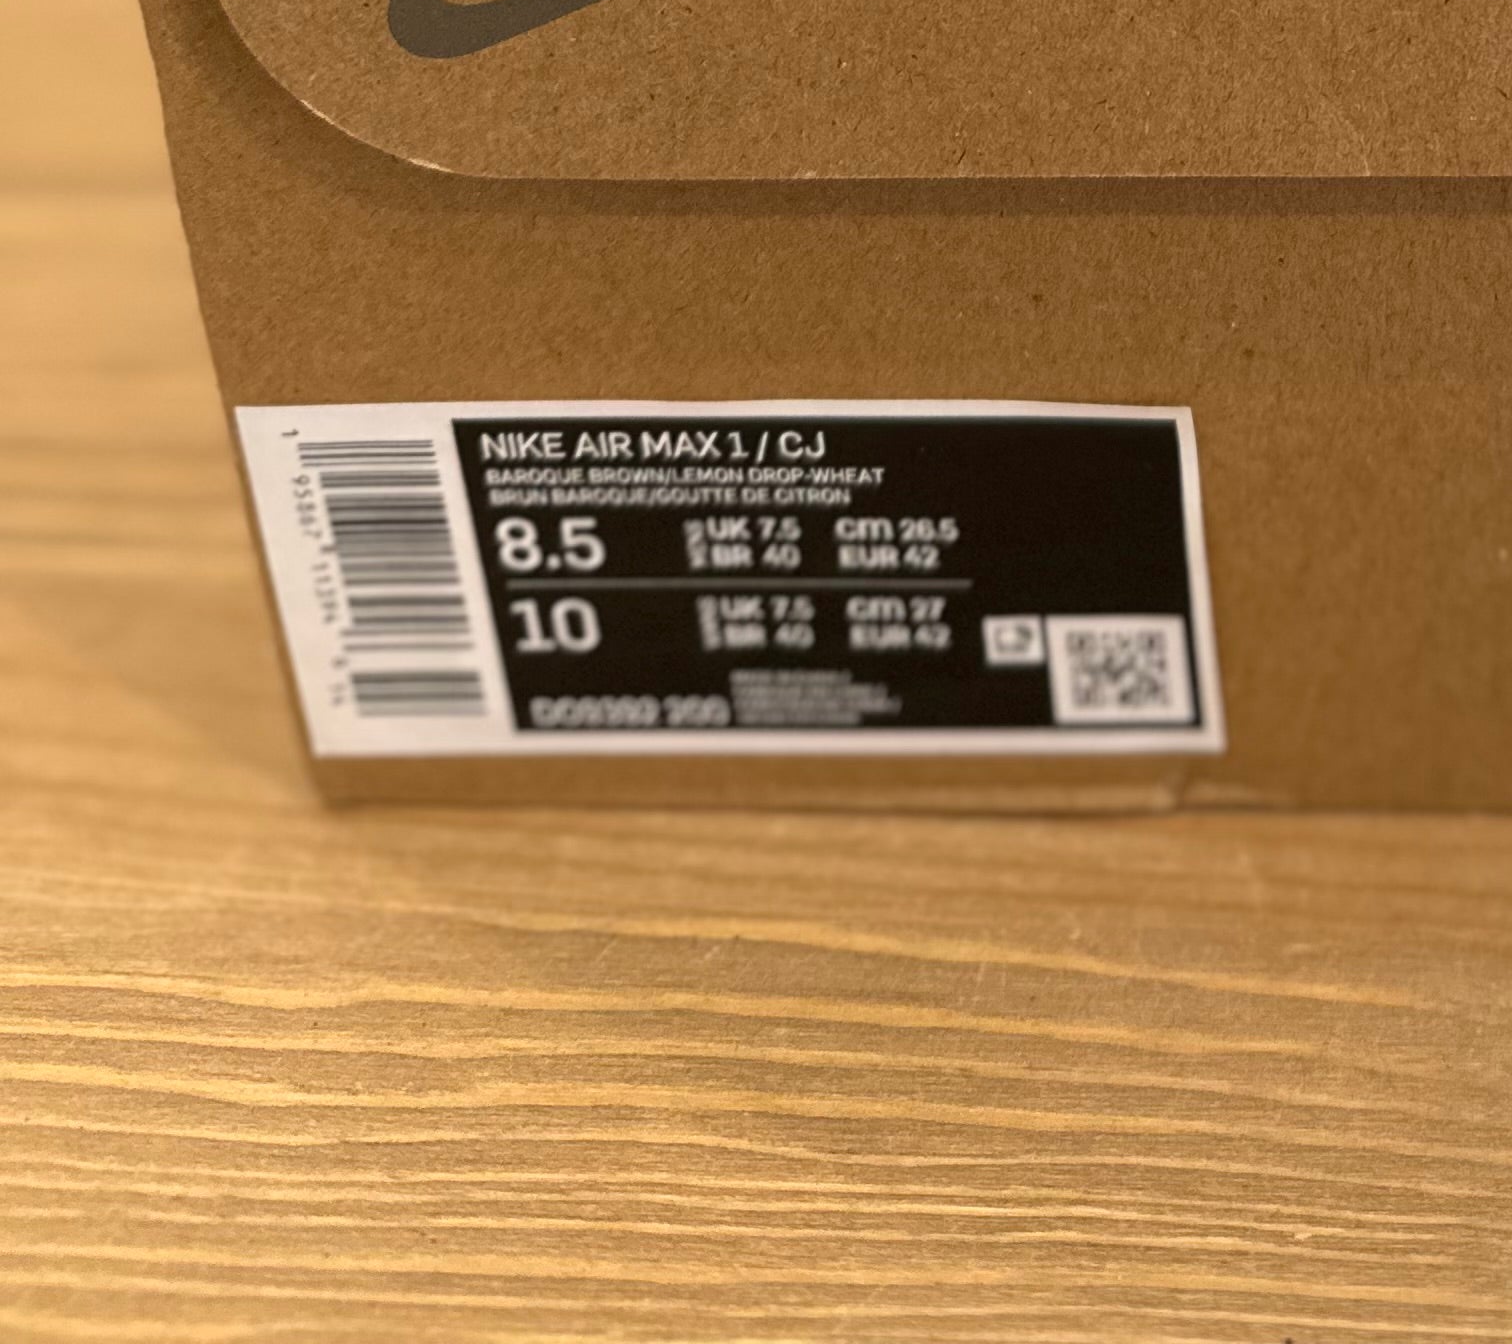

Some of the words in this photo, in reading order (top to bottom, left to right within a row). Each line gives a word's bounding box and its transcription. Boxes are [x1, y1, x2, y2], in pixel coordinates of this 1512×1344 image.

[480, 431, 566, 460] NIKE
[574, 431, 634, 459] AIR
[641, 430, 722, 459] MAX
[728, 430, 749, 459] 1
[777, 429, 827, 460] CJ
[485, 467, 583, 486] BAROQUE
[588, 467, 743, 486] BROWN/LEMON
[489, 487, 548, 507] BRUN
[742, 487, 771, 506] DE
[774, 486, 851, 506] CITRON
[705, 516, 752, 541] UK
[757, 516, 802, 542] 7.5
[495, 516, 606, 572] 8.5
[838, 543, 900, 569] EUR
[902, 543, 941, 569] 42
[509, 597, 602, 654] 10
